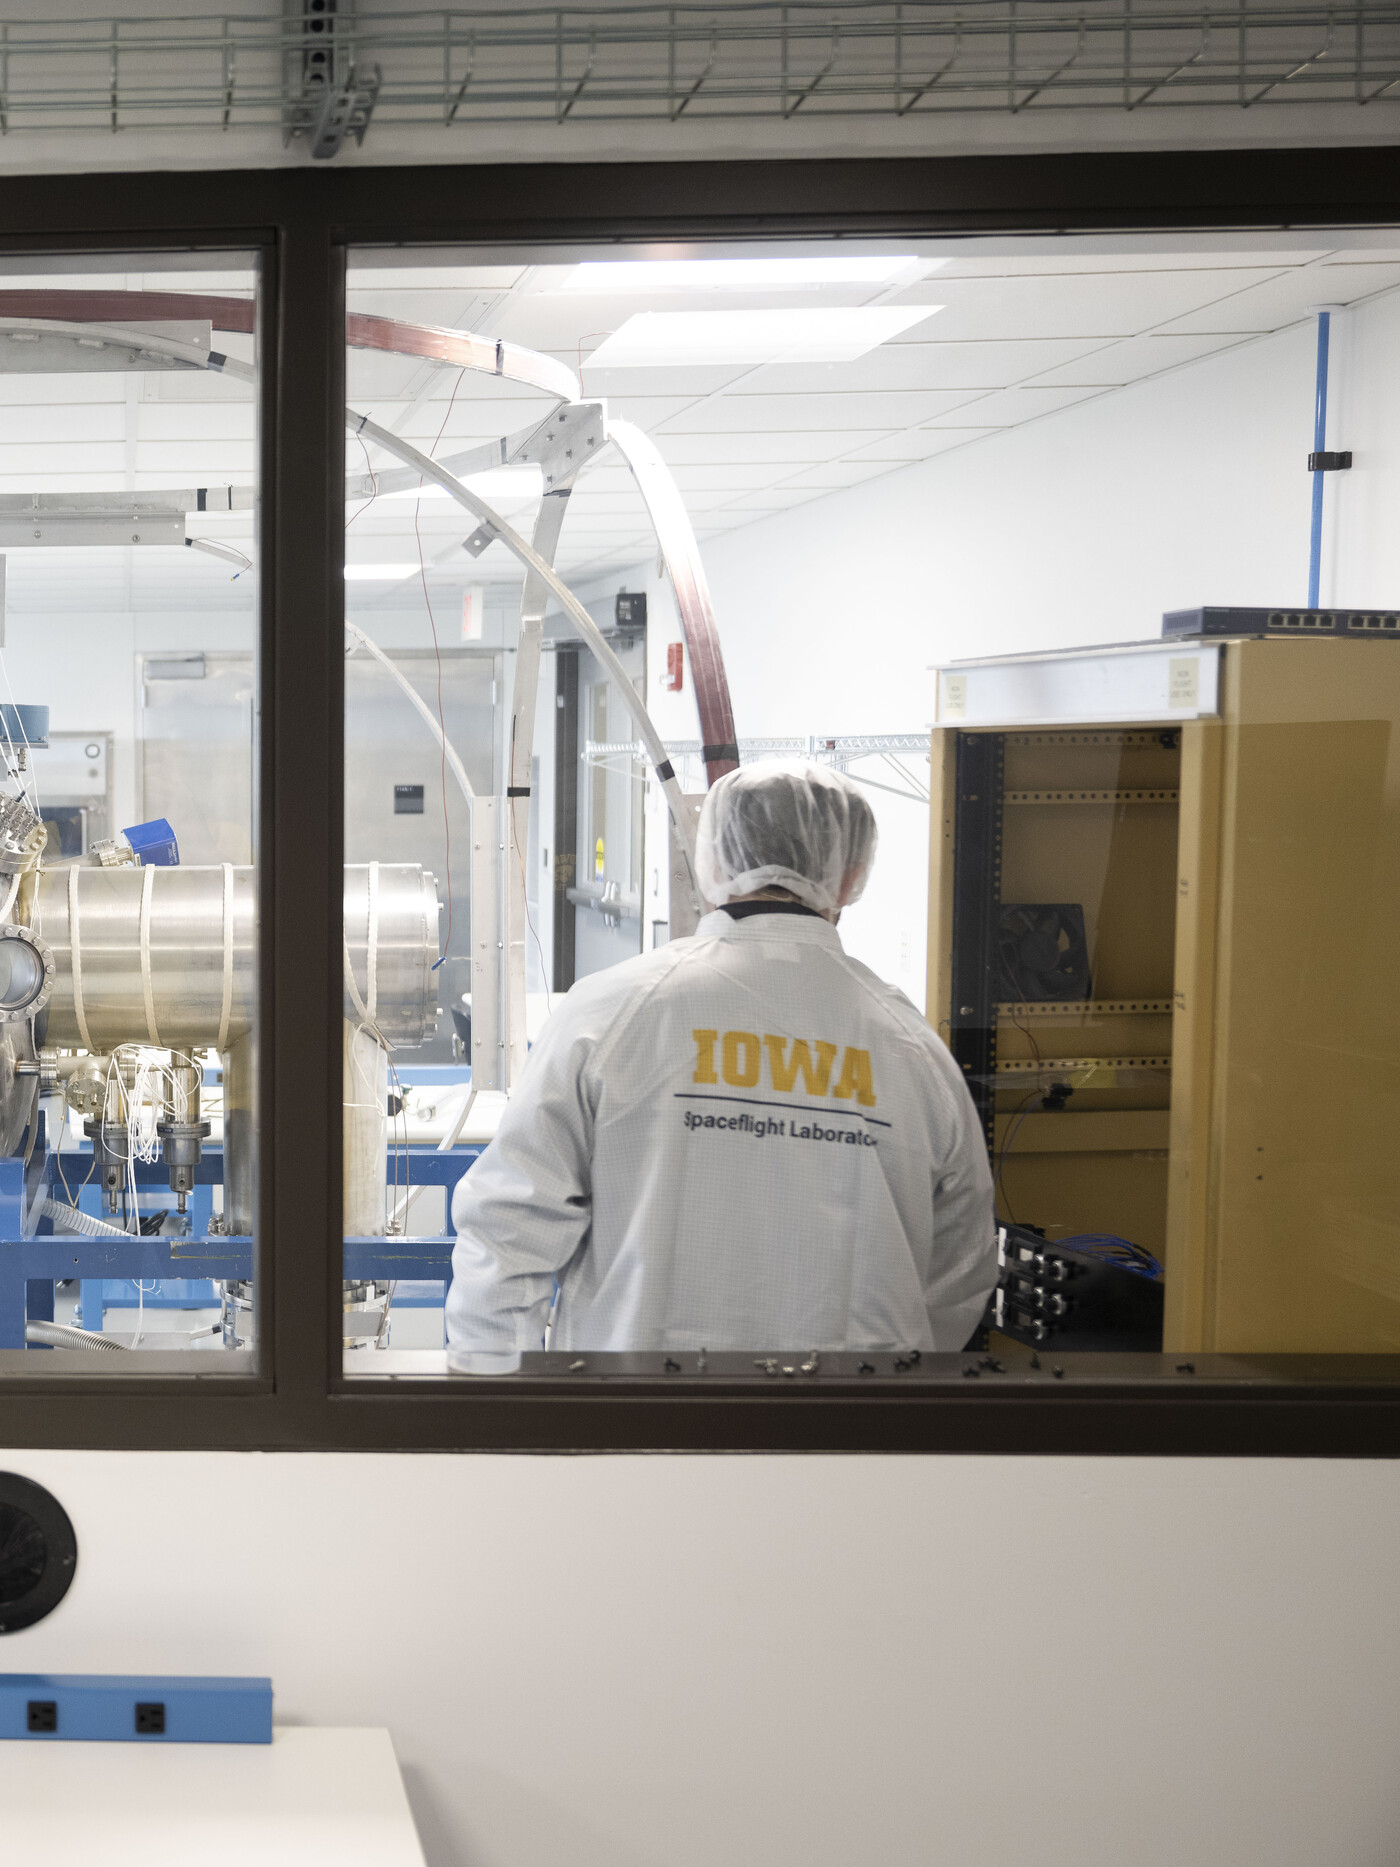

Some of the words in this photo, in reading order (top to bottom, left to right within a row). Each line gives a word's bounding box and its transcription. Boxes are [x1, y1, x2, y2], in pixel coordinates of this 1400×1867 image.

[692, 1029, 877, 1107] IOWA
[684, 1110, 785, 1138] Spaceflight
[790, 1120, 878, 1147] Laborato
